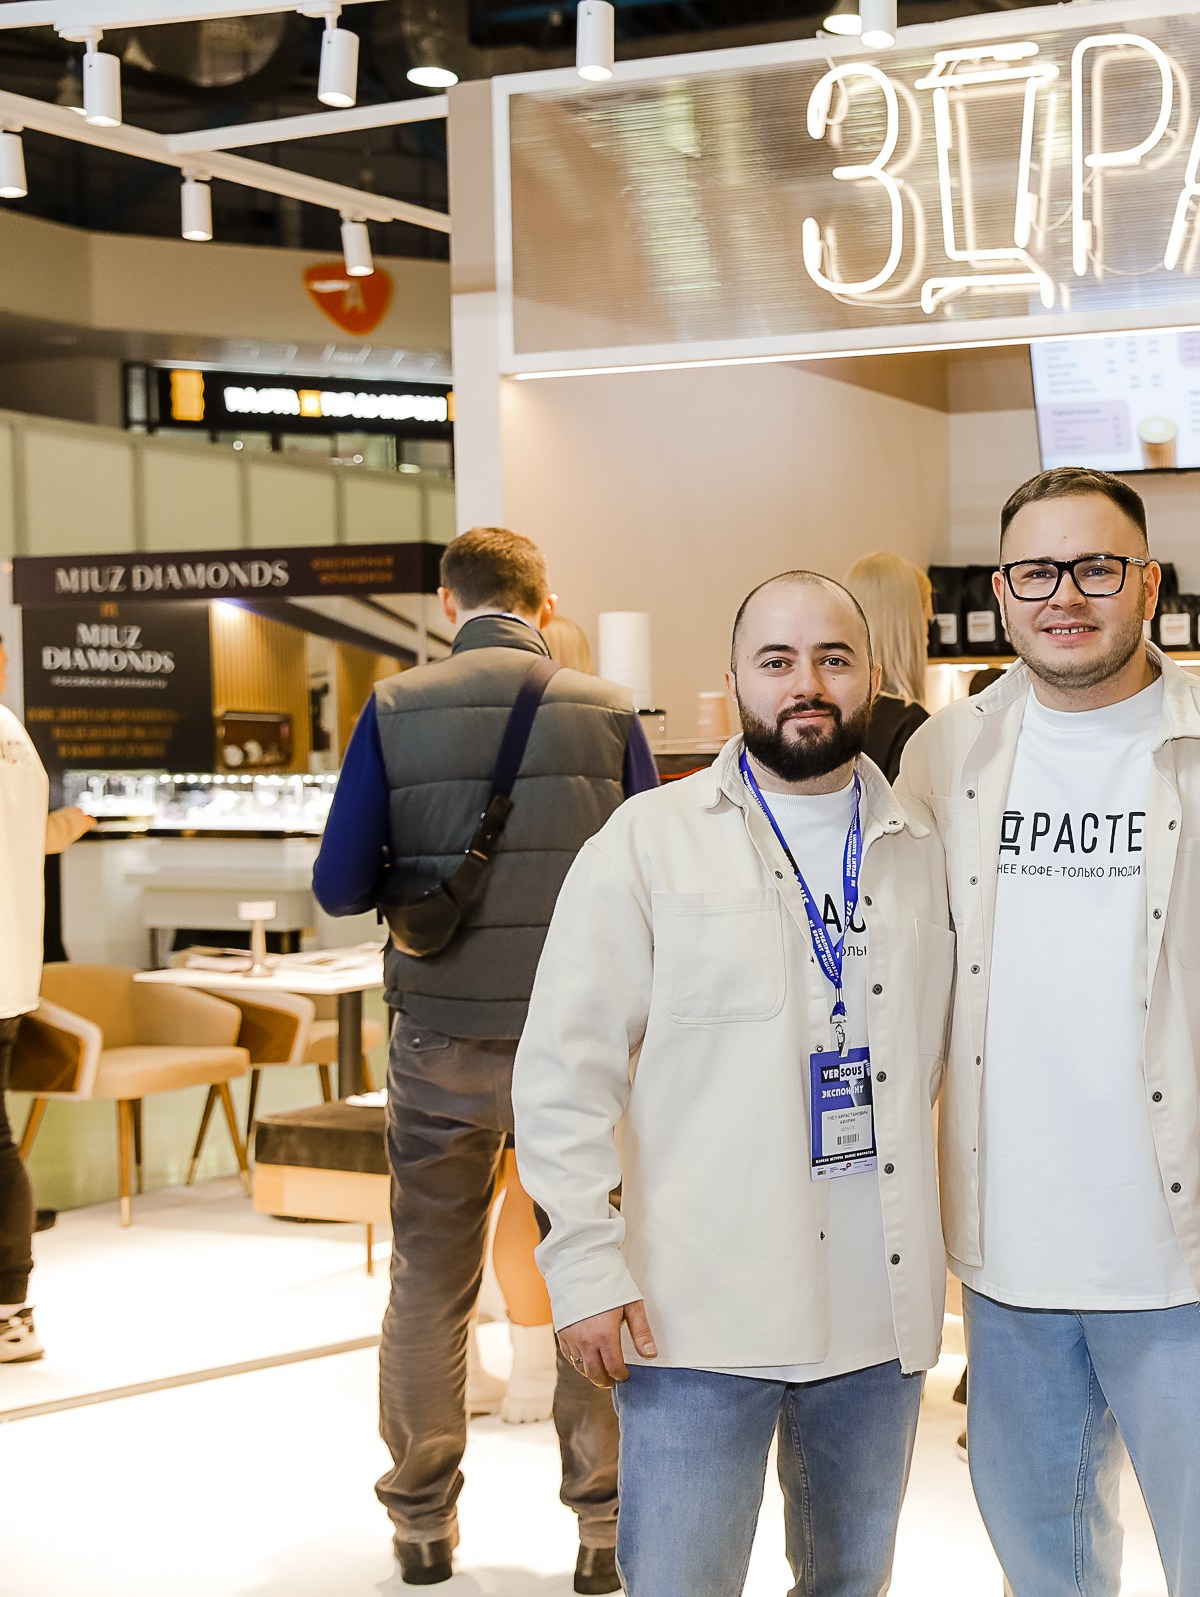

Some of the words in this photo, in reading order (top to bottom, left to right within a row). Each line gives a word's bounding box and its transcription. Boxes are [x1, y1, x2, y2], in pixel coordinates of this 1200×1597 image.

[55, 566, 126, 593] MIUZ
[131, 559, 290, 591] DIAMONDS
[77, 622, 142, 649] MIUZ
[41, 646, 175, 674] DIAMONDS
[1108, 865, 1141, 878] ЛЮДИ
[821, 1085, 864, 1099] ЭКСПОННТ
